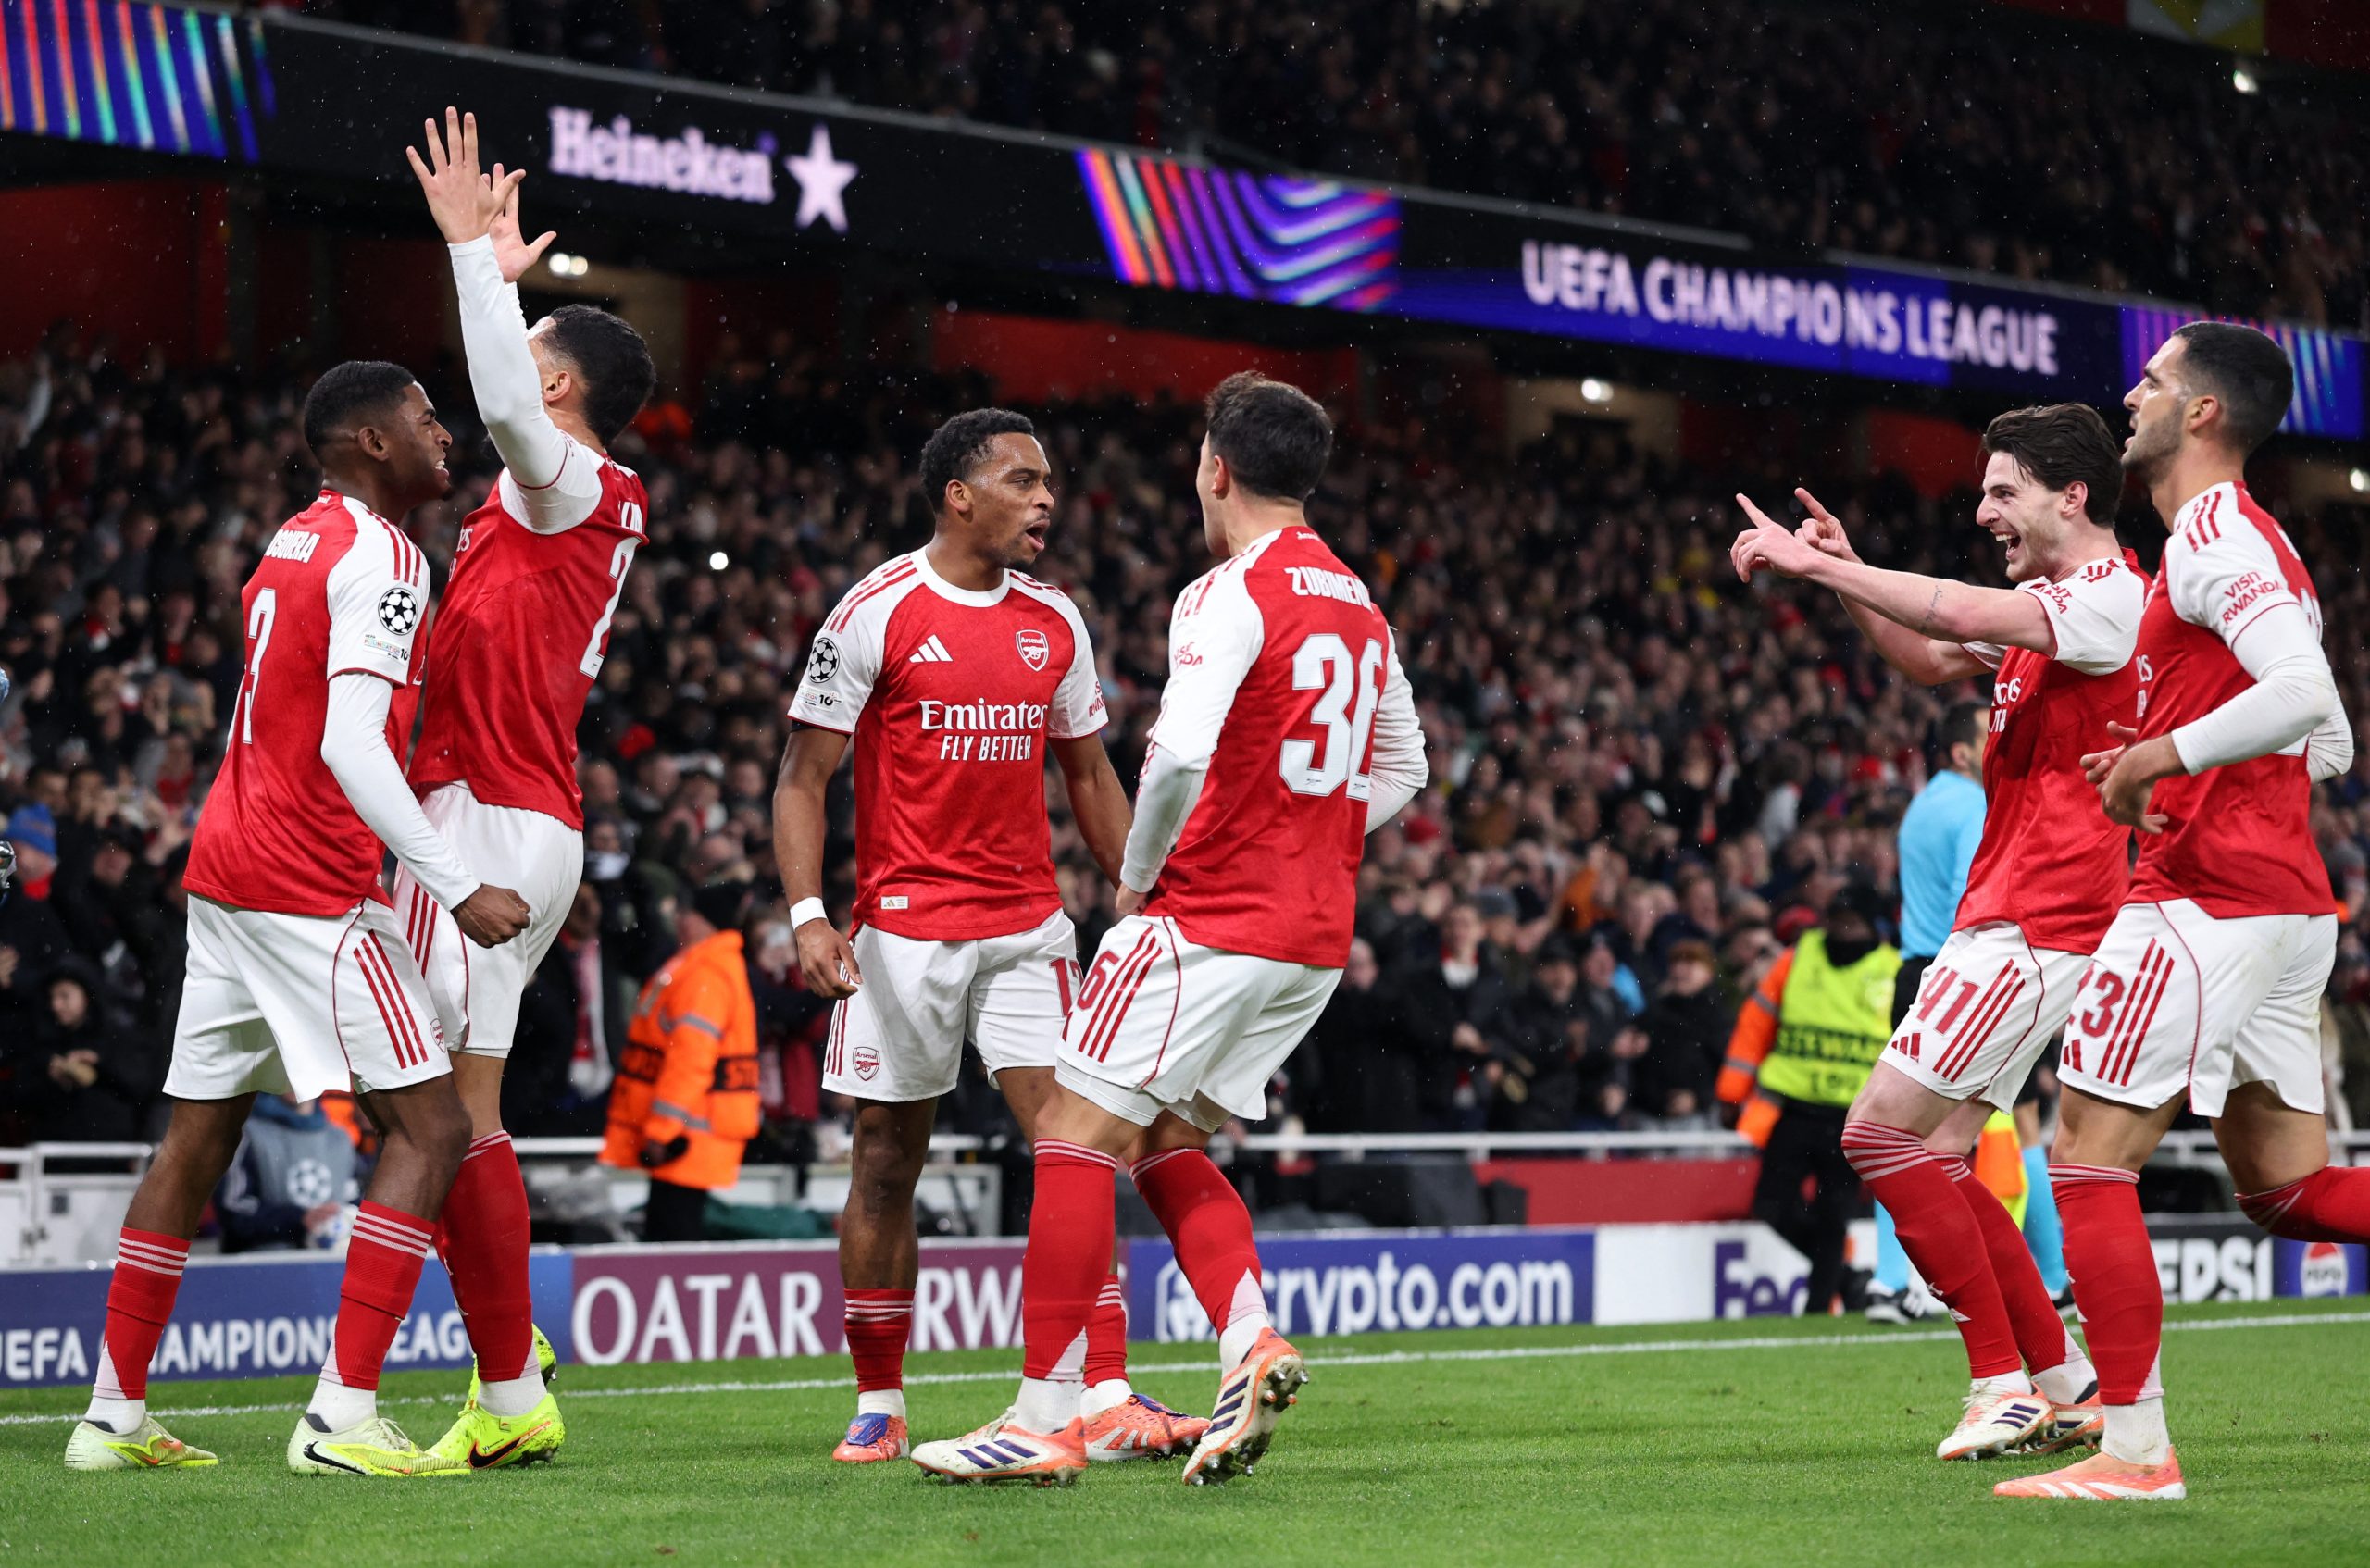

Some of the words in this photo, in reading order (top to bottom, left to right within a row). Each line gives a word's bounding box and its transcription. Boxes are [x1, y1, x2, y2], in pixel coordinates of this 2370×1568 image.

[549, 106, 776, 204] Heineken
[1522, 240, 1639, 317] UEFA
[1644, 257, 1901, 355] CHAMPIONS
[1905, 295, 2059, 375] LEAGUE
[2225, 571, 2261, 598] VISIT
[1020, 636, 1044, 645] Arsenal
[919, 697, 1048, 731] Emirates
[1279, 633, 1383, 803] 36
[940, 735, 975, 762] FLY
[978, 735, 1032, 762] BETTER
[1915, 965, 1980, 1035] 41
[2150, 1236, 2275, 1302] EPSI
[0, 1326, 89, 1381] EFA
